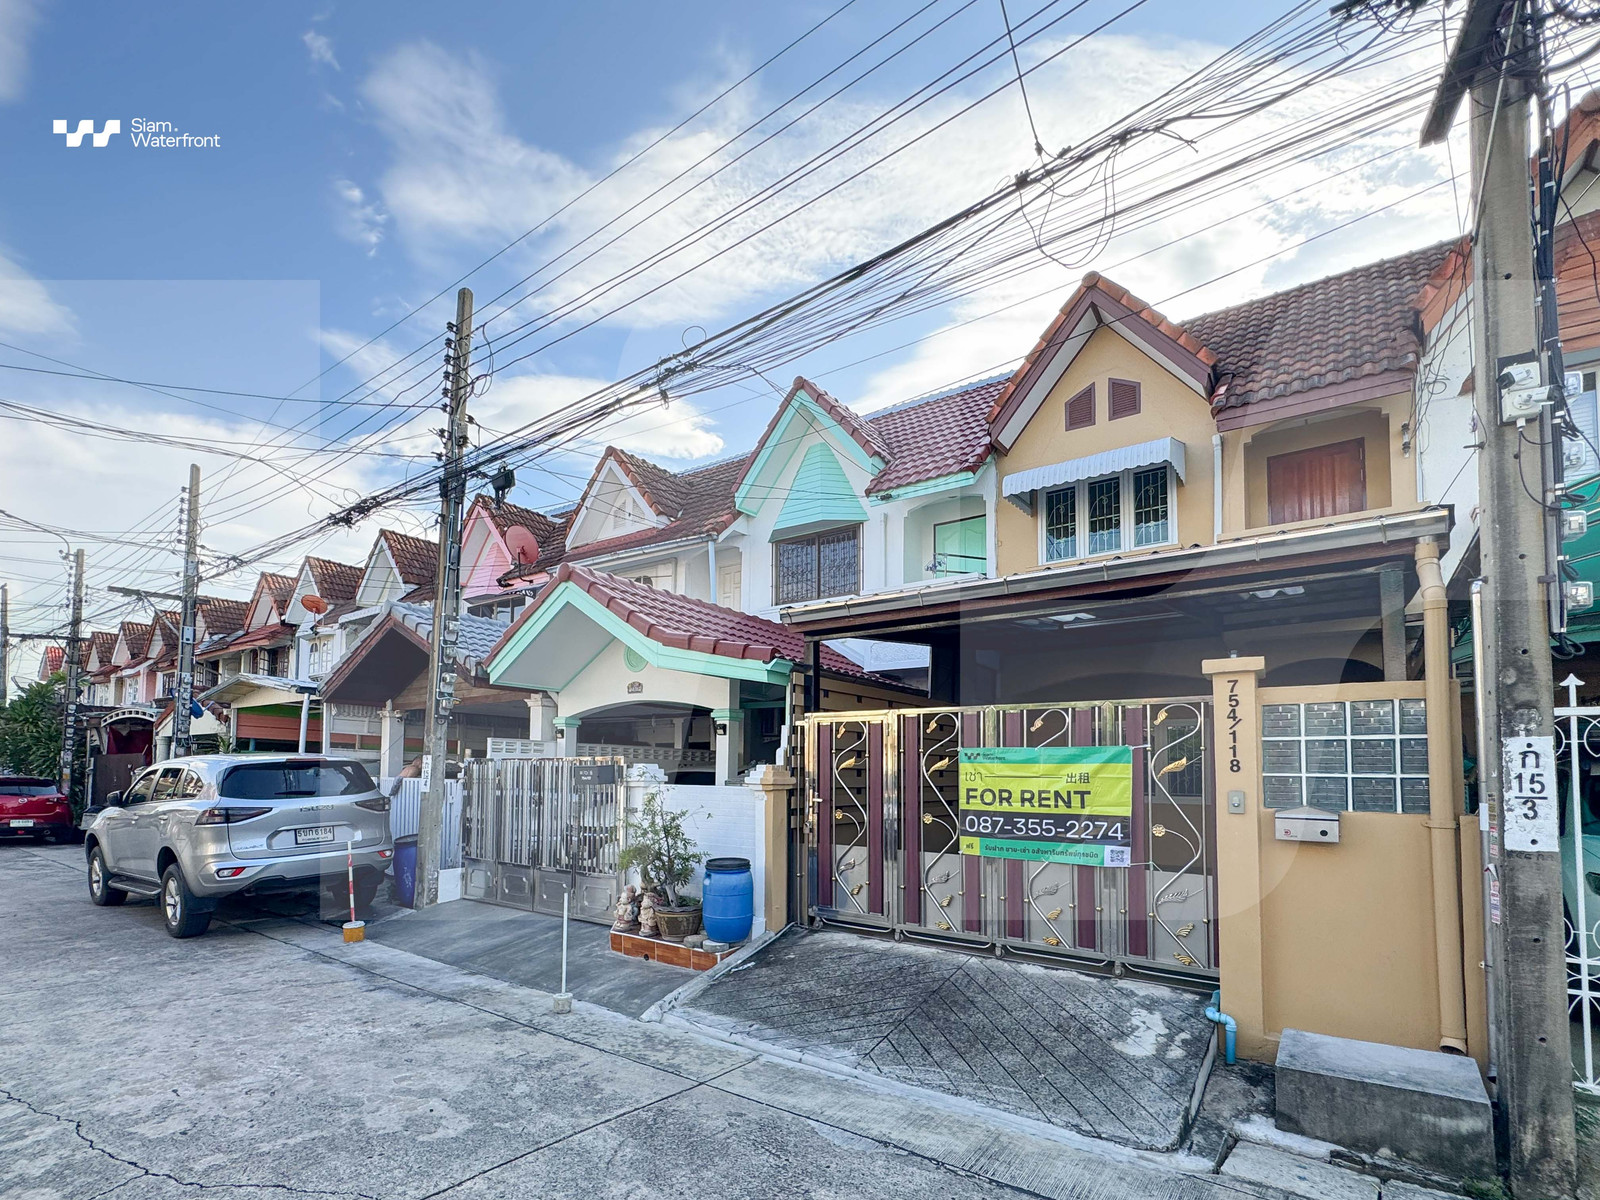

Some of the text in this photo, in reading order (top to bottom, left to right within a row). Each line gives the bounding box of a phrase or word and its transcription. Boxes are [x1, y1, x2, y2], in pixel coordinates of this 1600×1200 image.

[1227, 680, 1243, 773] 754/118
[965, 769, 983, 782] เช่า
[1066, 772, 1090, 784] 出租
[1513, 772, 1546, 795] 15
[965, 788, 1091, 810] FOR RENT
[1522, 799, 1539, 821] 3
[965, 815, 1124, 841] 087-355-2274
